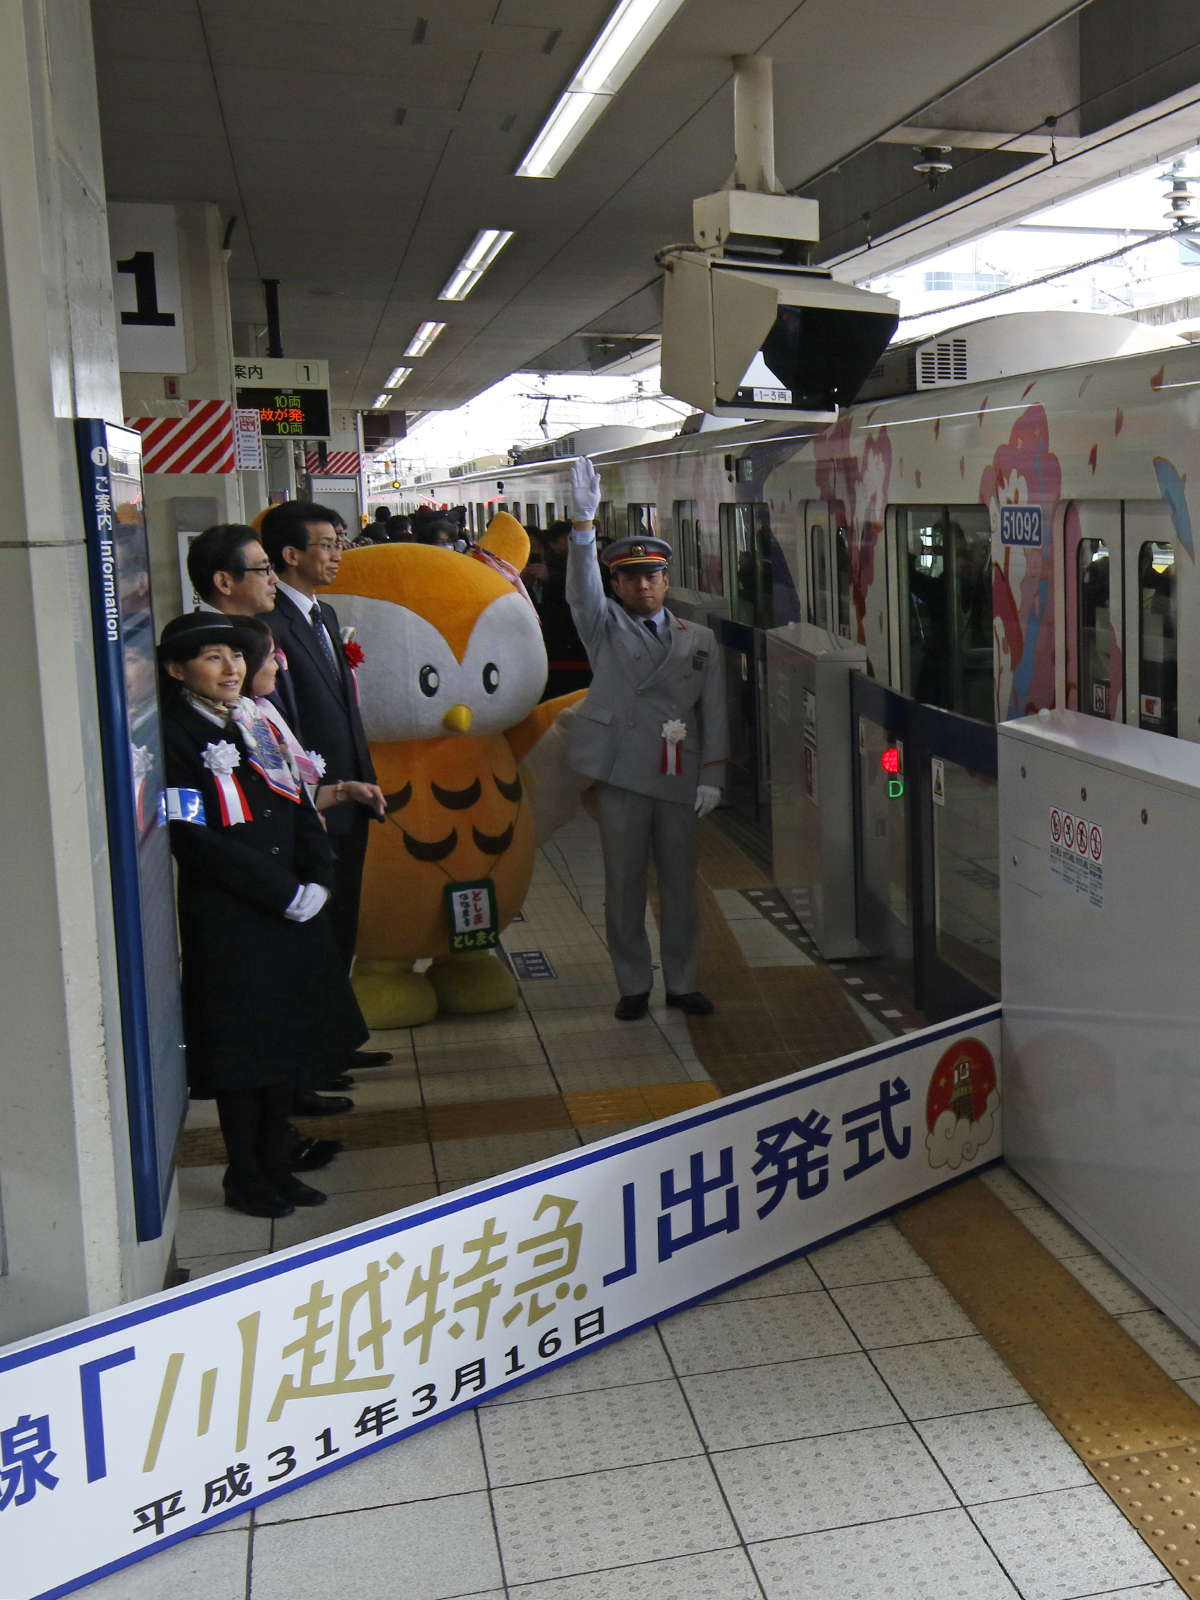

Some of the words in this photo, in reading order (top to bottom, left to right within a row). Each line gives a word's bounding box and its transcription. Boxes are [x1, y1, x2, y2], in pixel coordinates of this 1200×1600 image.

[117, 251, 176, 327] 1
[234, 364, 264, 380] 案内
[303, 365, 311, 382] 1
[95, 476, 113, 531] ご案内
[1003, 511, 1040, 542] 51092
[101, 540, 120, 641] Information
[132, 1306, 606, 1538] 平成31年3月16日
